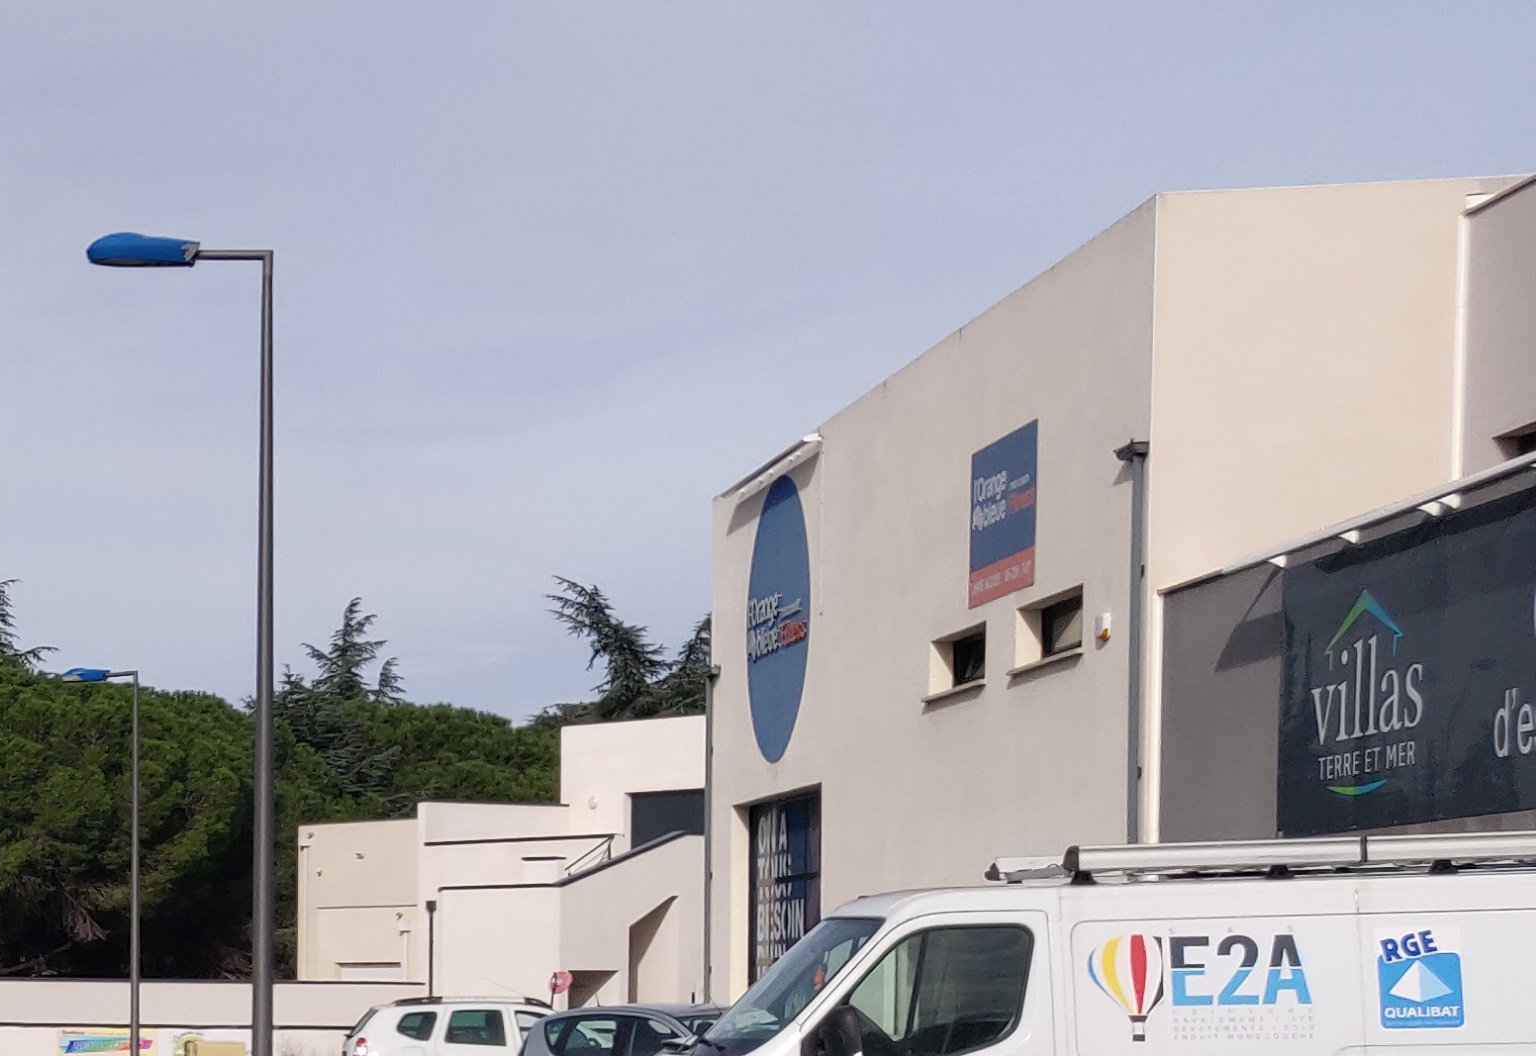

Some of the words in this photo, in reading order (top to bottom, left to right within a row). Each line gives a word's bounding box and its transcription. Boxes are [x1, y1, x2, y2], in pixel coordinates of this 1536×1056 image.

[1311, 634, 1423, 746] villas
[1493, 688, 1536, 759] d'e
[1318, 751, 1361, 781] TERRE
[1365, 747, 1382, 773] ET
[1386, 741, 1416, 769] MER
[757, 897, 805, 942] BESOIN
[1380, 930, 1438, 962] RGE
[1169, 935, 1313, 1006] E2A
[1384, 1006, 1460, 1019] QUALIBAT
